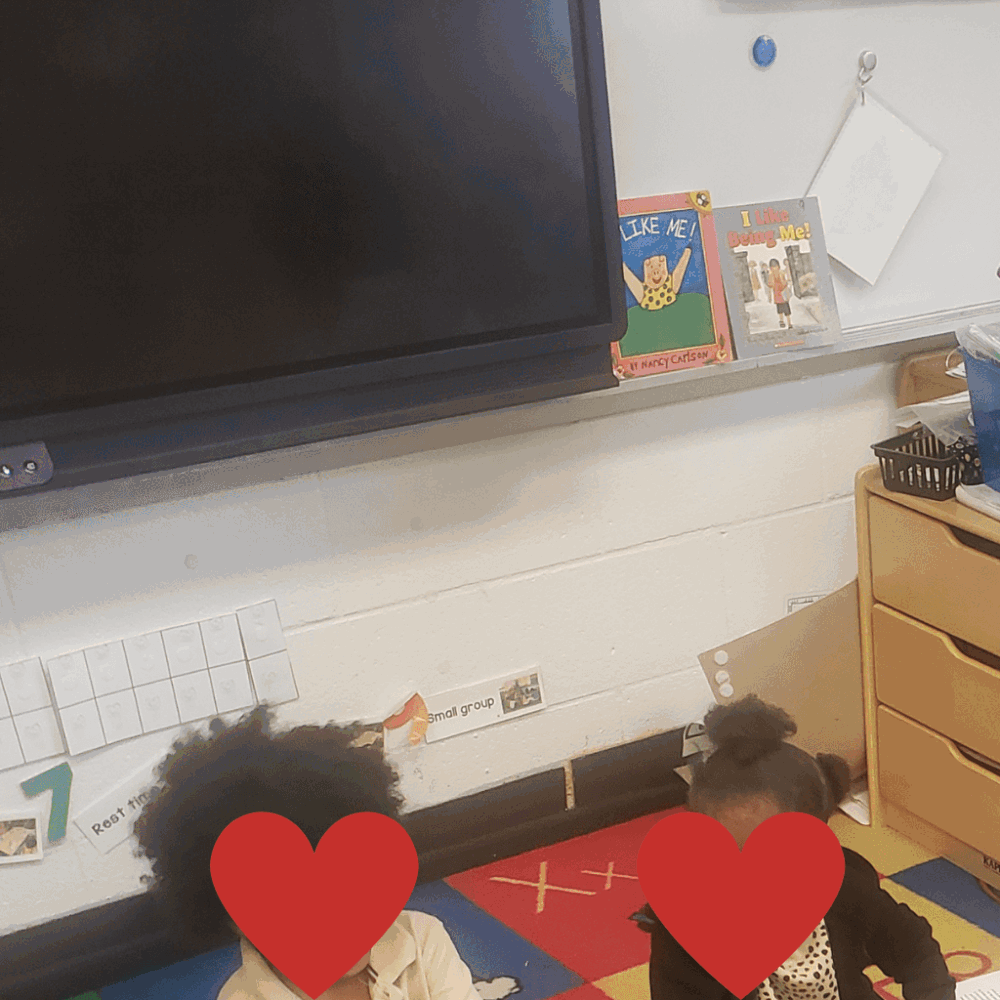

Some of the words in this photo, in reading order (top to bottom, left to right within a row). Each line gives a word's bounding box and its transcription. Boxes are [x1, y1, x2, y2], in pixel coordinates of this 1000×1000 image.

[619, 217, 660, 241] LIKE
[666, 218, 697, 242] ME!
[740, 210, 751, 228] I
[754, 207, 789, 225] Like
[728, 230, 777, 249] Being
[779, 222, 811, 241] Me!
[428, 706, 458, 724] Small
[460, 697, 495, 717] group
[91, 807, 125, 836] Rest
